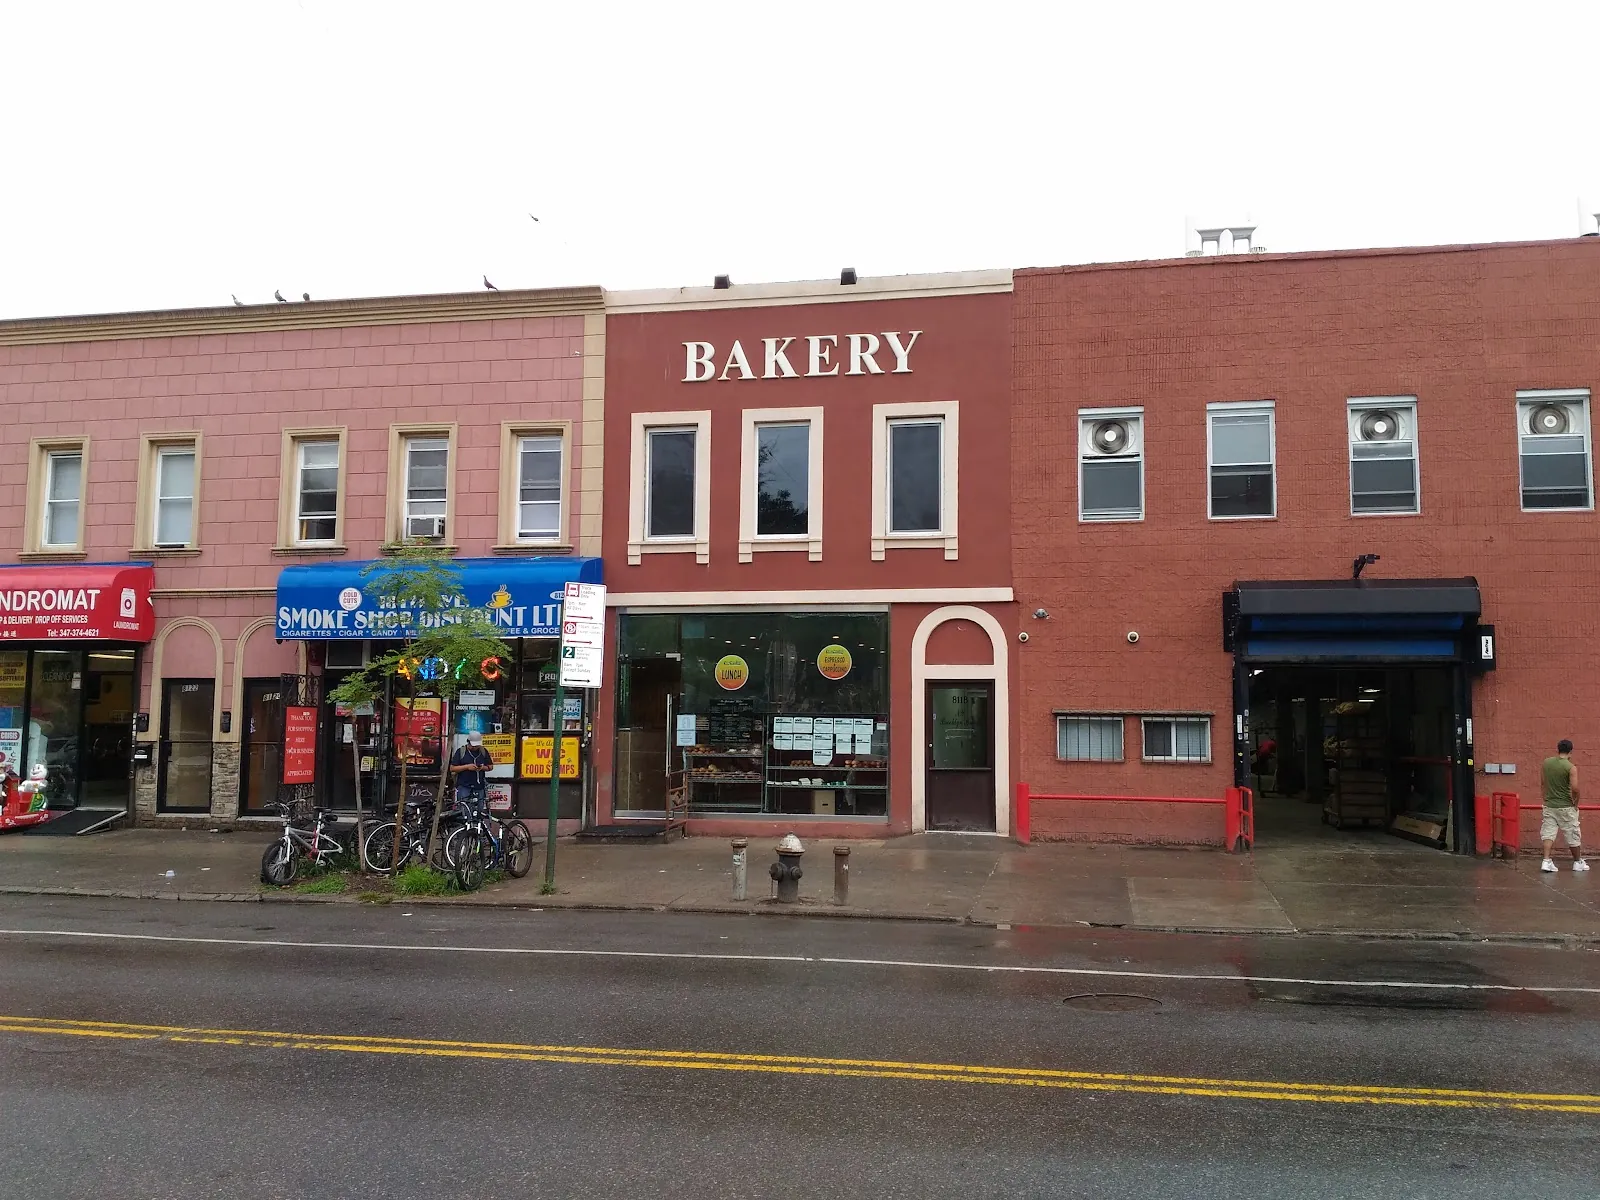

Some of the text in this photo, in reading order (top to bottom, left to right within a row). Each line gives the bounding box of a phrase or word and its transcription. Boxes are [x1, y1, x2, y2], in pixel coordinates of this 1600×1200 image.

[681, 331, 923, 382] BAKERY
[8, 616, 33, 625] DELIVERY
[35, 615, 50, 624] DROP
[51, 615, 61, 624] OFF
[62, 615, 88, 624] SERVICES
[278, 606, 348, 629] SMOKE
[420, 606, 527, 628] DISUNT
[113, 621, 140, 630] LAUNDROMAT
[47, 629, 99, 637] Tel: 347-374-4621
[565, 647, 572, 657] 2
[824, 656, 845, 664] ESPRESSO
[722, 670, 742, 680] LUNCH
[536, 748, 565, 759] WC
[525, 764, 575, 775] FOOD SMPS
